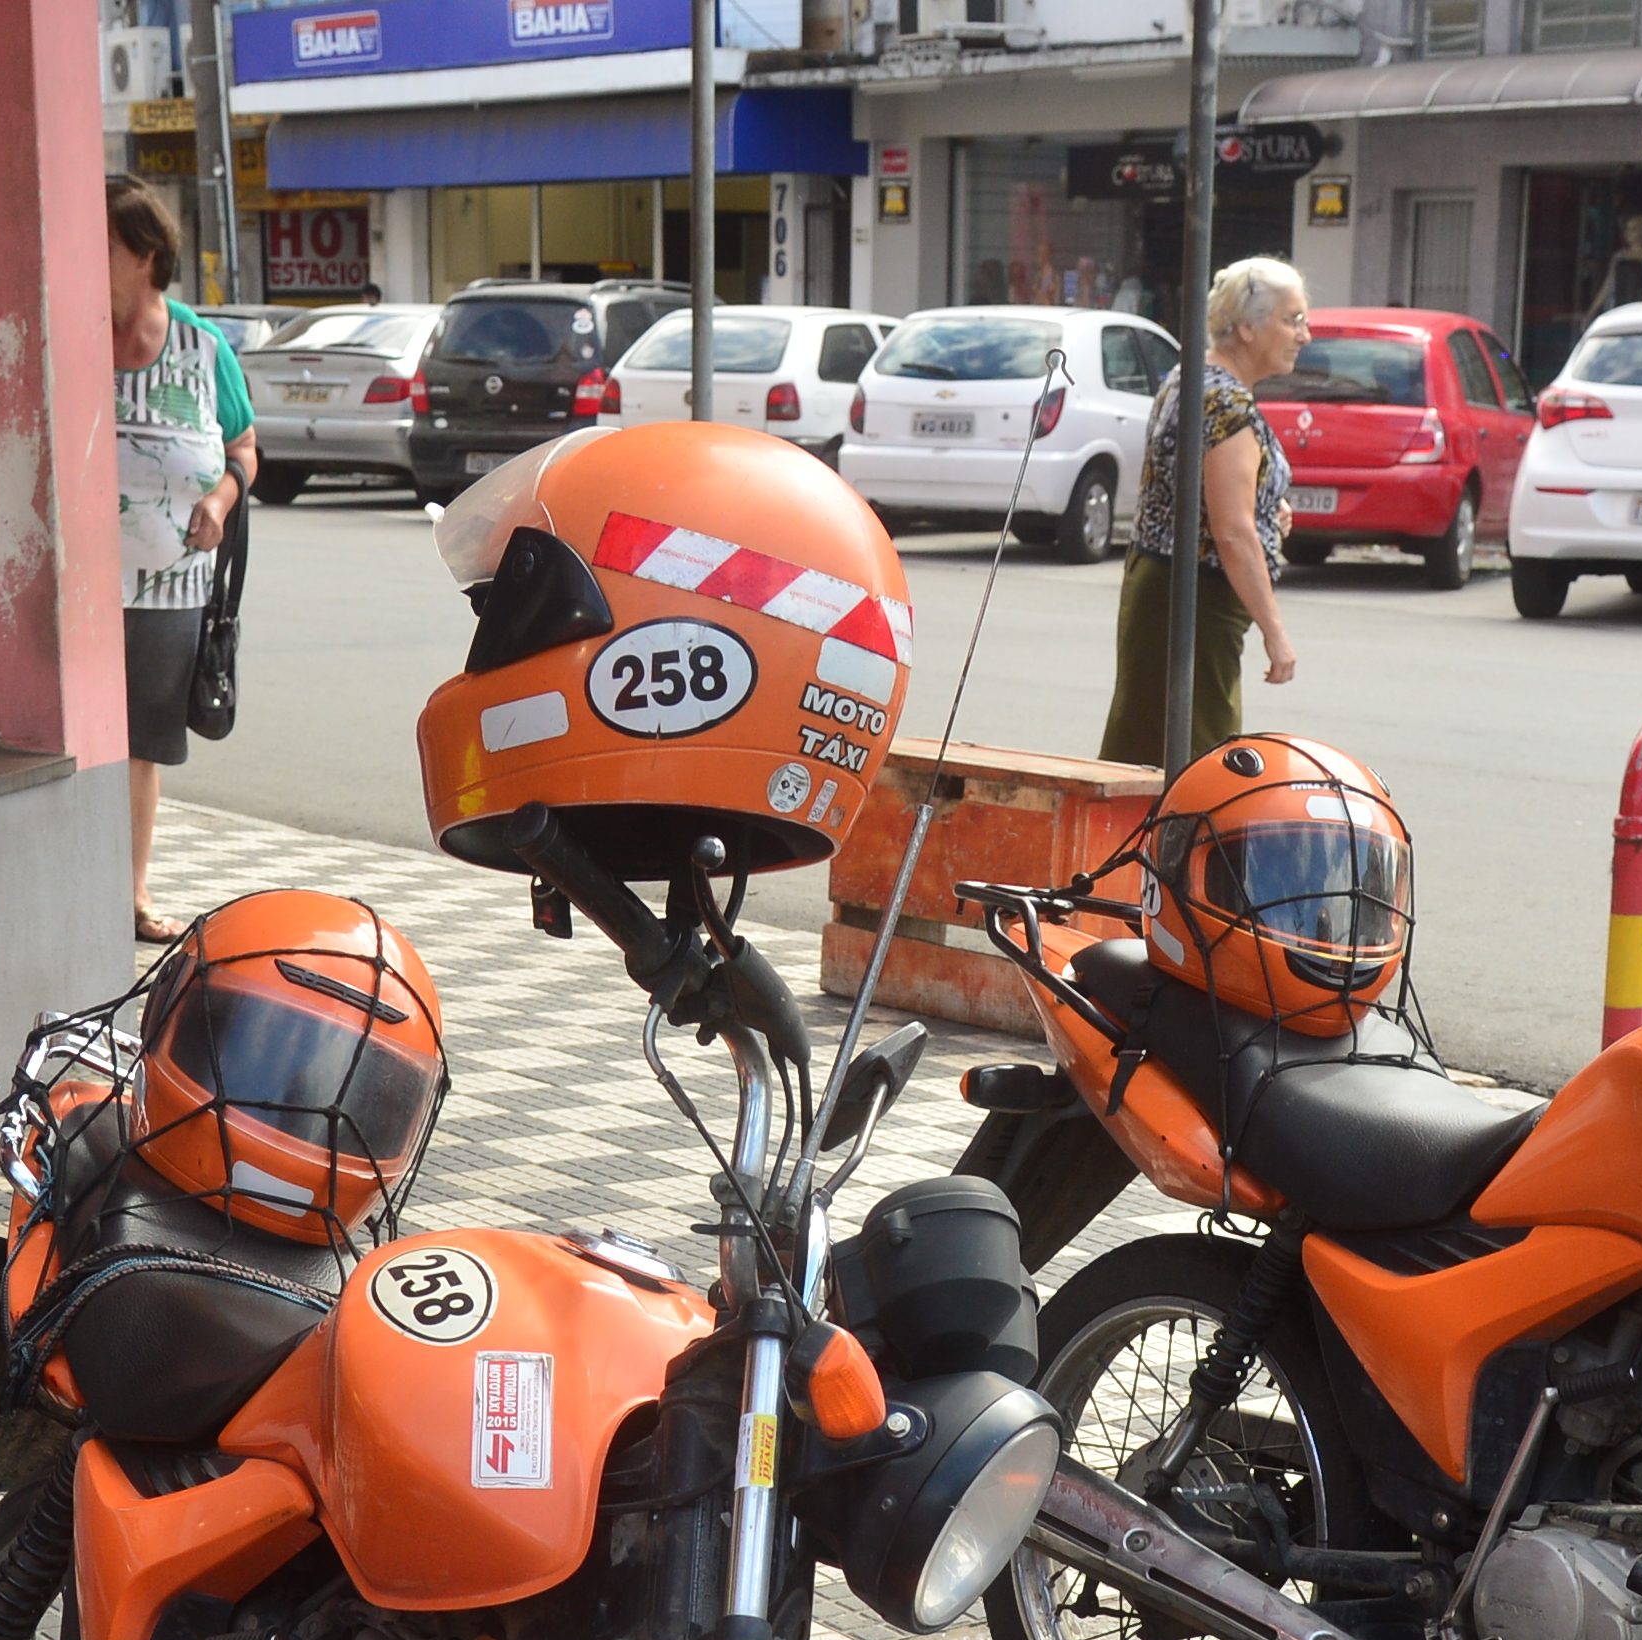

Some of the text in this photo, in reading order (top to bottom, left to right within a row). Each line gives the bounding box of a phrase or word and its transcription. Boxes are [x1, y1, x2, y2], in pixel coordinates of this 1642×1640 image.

[298, 28, 361, 59] BAHIA
[516, 4, 591, 38] BAHIA
[611, 645, 728, 711] 258
[800, 682, 886, 735] MOTO
[798, 724, 869, 774] TÁXI
[386, 1253, 473, 1328] 258
[489, 1364, 503, 1412] MOTOTÁXI
[504, 1364, 517, 1414] VISTORIADO
[487, 1416, 517, 1428] 2015
[533, 1434, 538, 1442] DE
[763, 1424, 775, 1480] David
